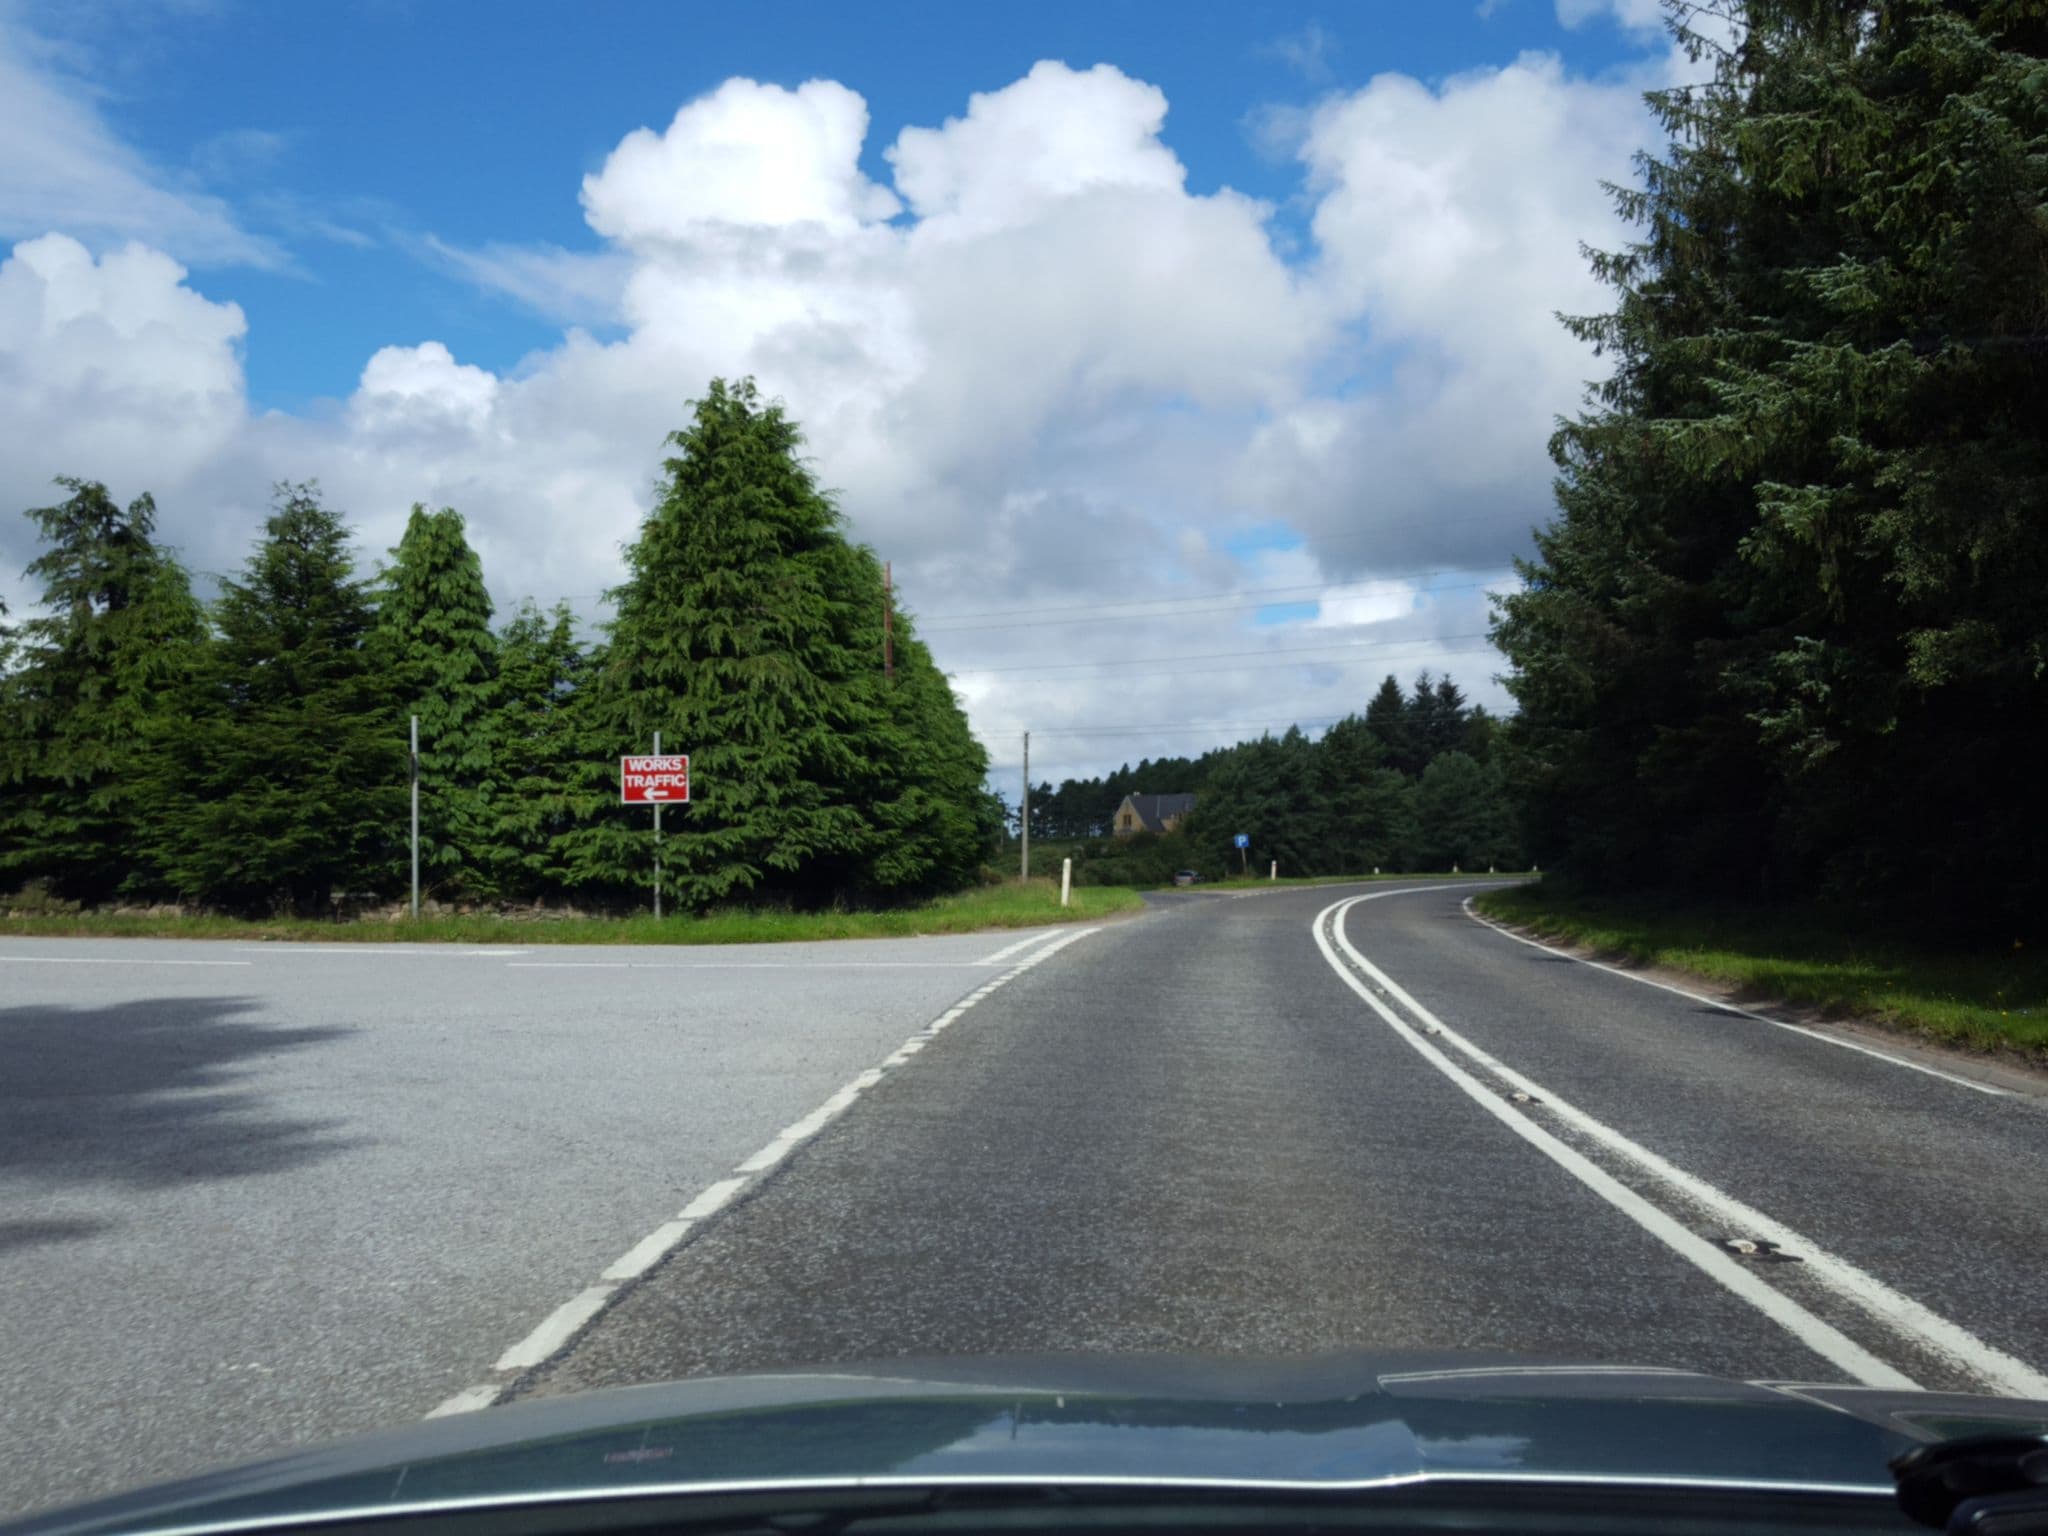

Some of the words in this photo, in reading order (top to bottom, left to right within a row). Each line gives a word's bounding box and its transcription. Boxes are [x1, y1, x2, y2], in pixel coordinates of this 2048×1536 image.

[629, 759, 682, 771] WORKS
[625, 774, 685, 787] TRAFFIC
[1238, 835, 1246, 847] P
